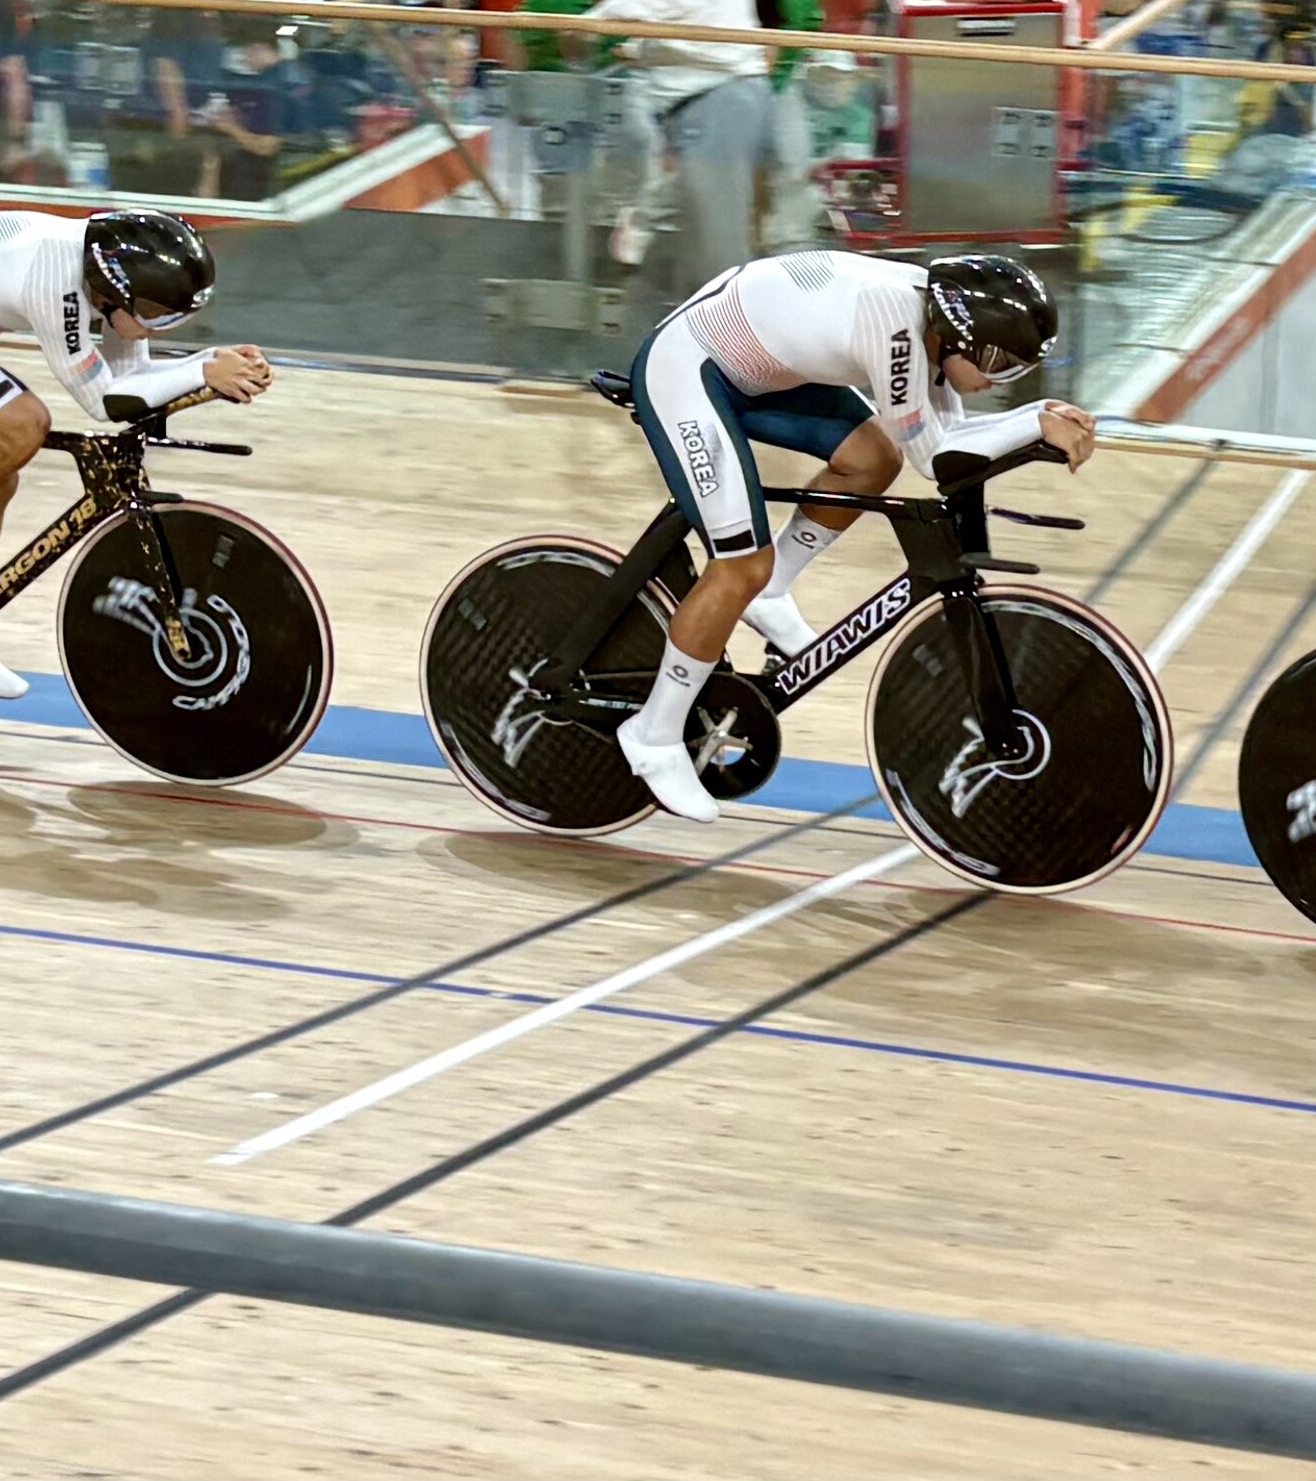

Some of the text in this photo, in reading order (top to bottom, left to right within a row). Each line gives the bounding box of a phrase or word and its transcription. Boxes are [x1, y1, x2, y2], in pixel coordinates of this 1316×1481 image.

[60, 291, 80, 356] KOREA
[890, 328, 912, 407] KOREA
[676, 419, 719, 499] KOREA
[69, 497, 97, 530] 18
[777, 578, 911, 695] WIAWIS
